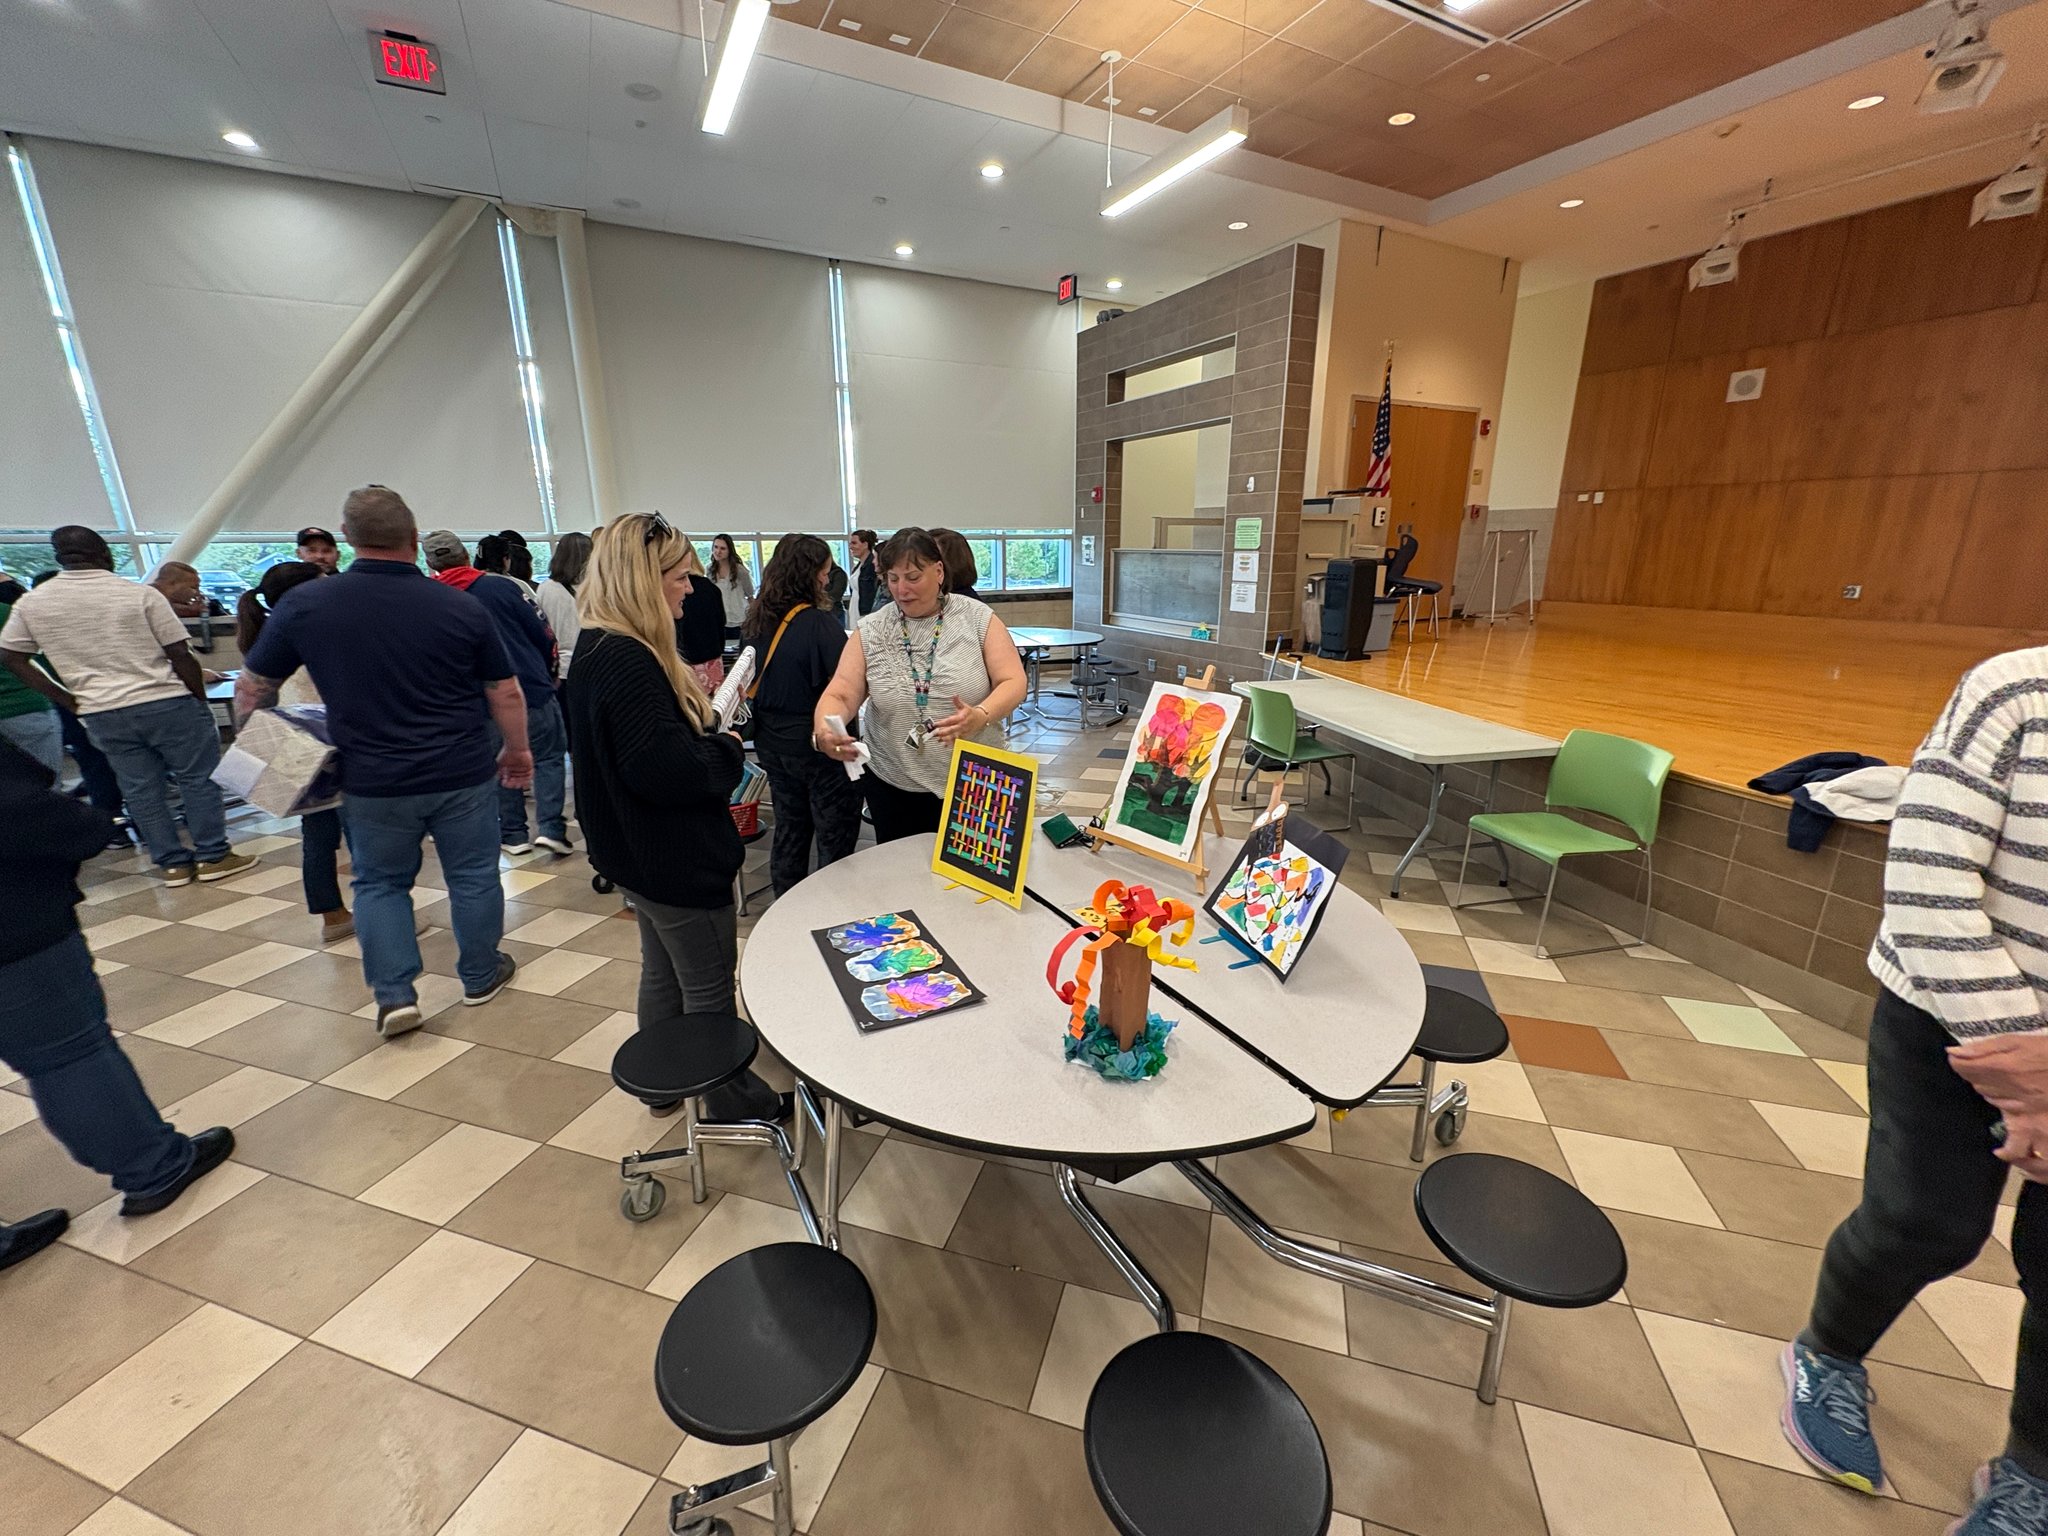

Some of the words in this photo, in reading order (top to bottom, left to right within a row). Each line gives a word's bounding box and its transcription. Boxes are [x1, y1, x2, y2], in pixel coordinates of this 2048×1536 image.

[381, 40, 429, 82] EXIT
[1060, 279, 1071, 300] EXIT
[1795, 1359, 1812, 1402] HOKA
